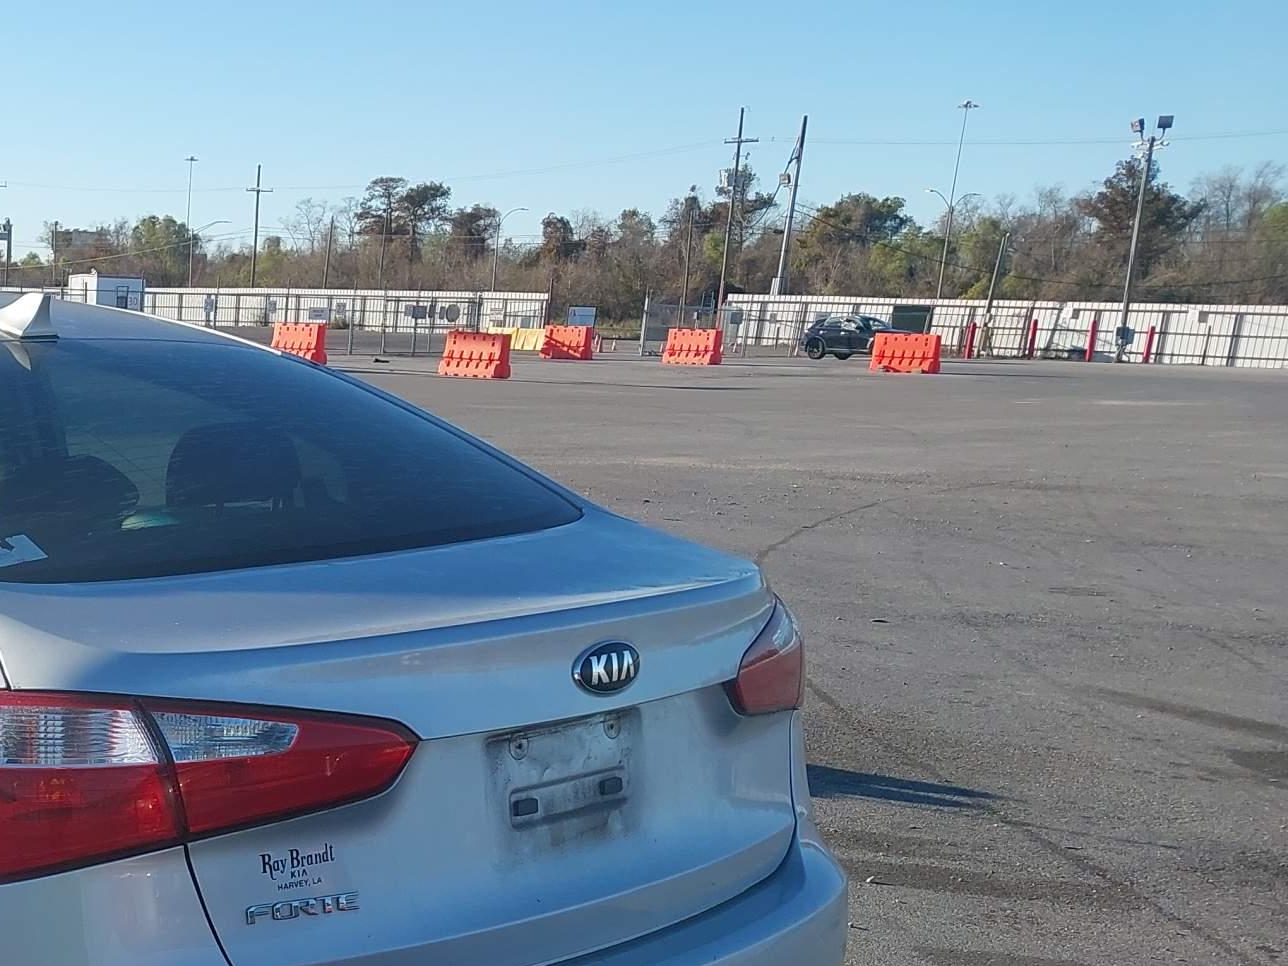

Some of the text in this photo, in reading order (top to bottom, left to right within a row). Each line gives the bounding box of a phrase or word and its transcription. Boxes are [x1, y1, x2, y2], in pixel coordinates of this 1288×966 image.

[589, 650, 635, 686] KIA
[259, 843, 336, 881] Ray Brandt
[290, 869, 308, 879] KIA
[277, 877, 323, 892] HARVEY, LA
[246, 891, 360, 925] FORTE
